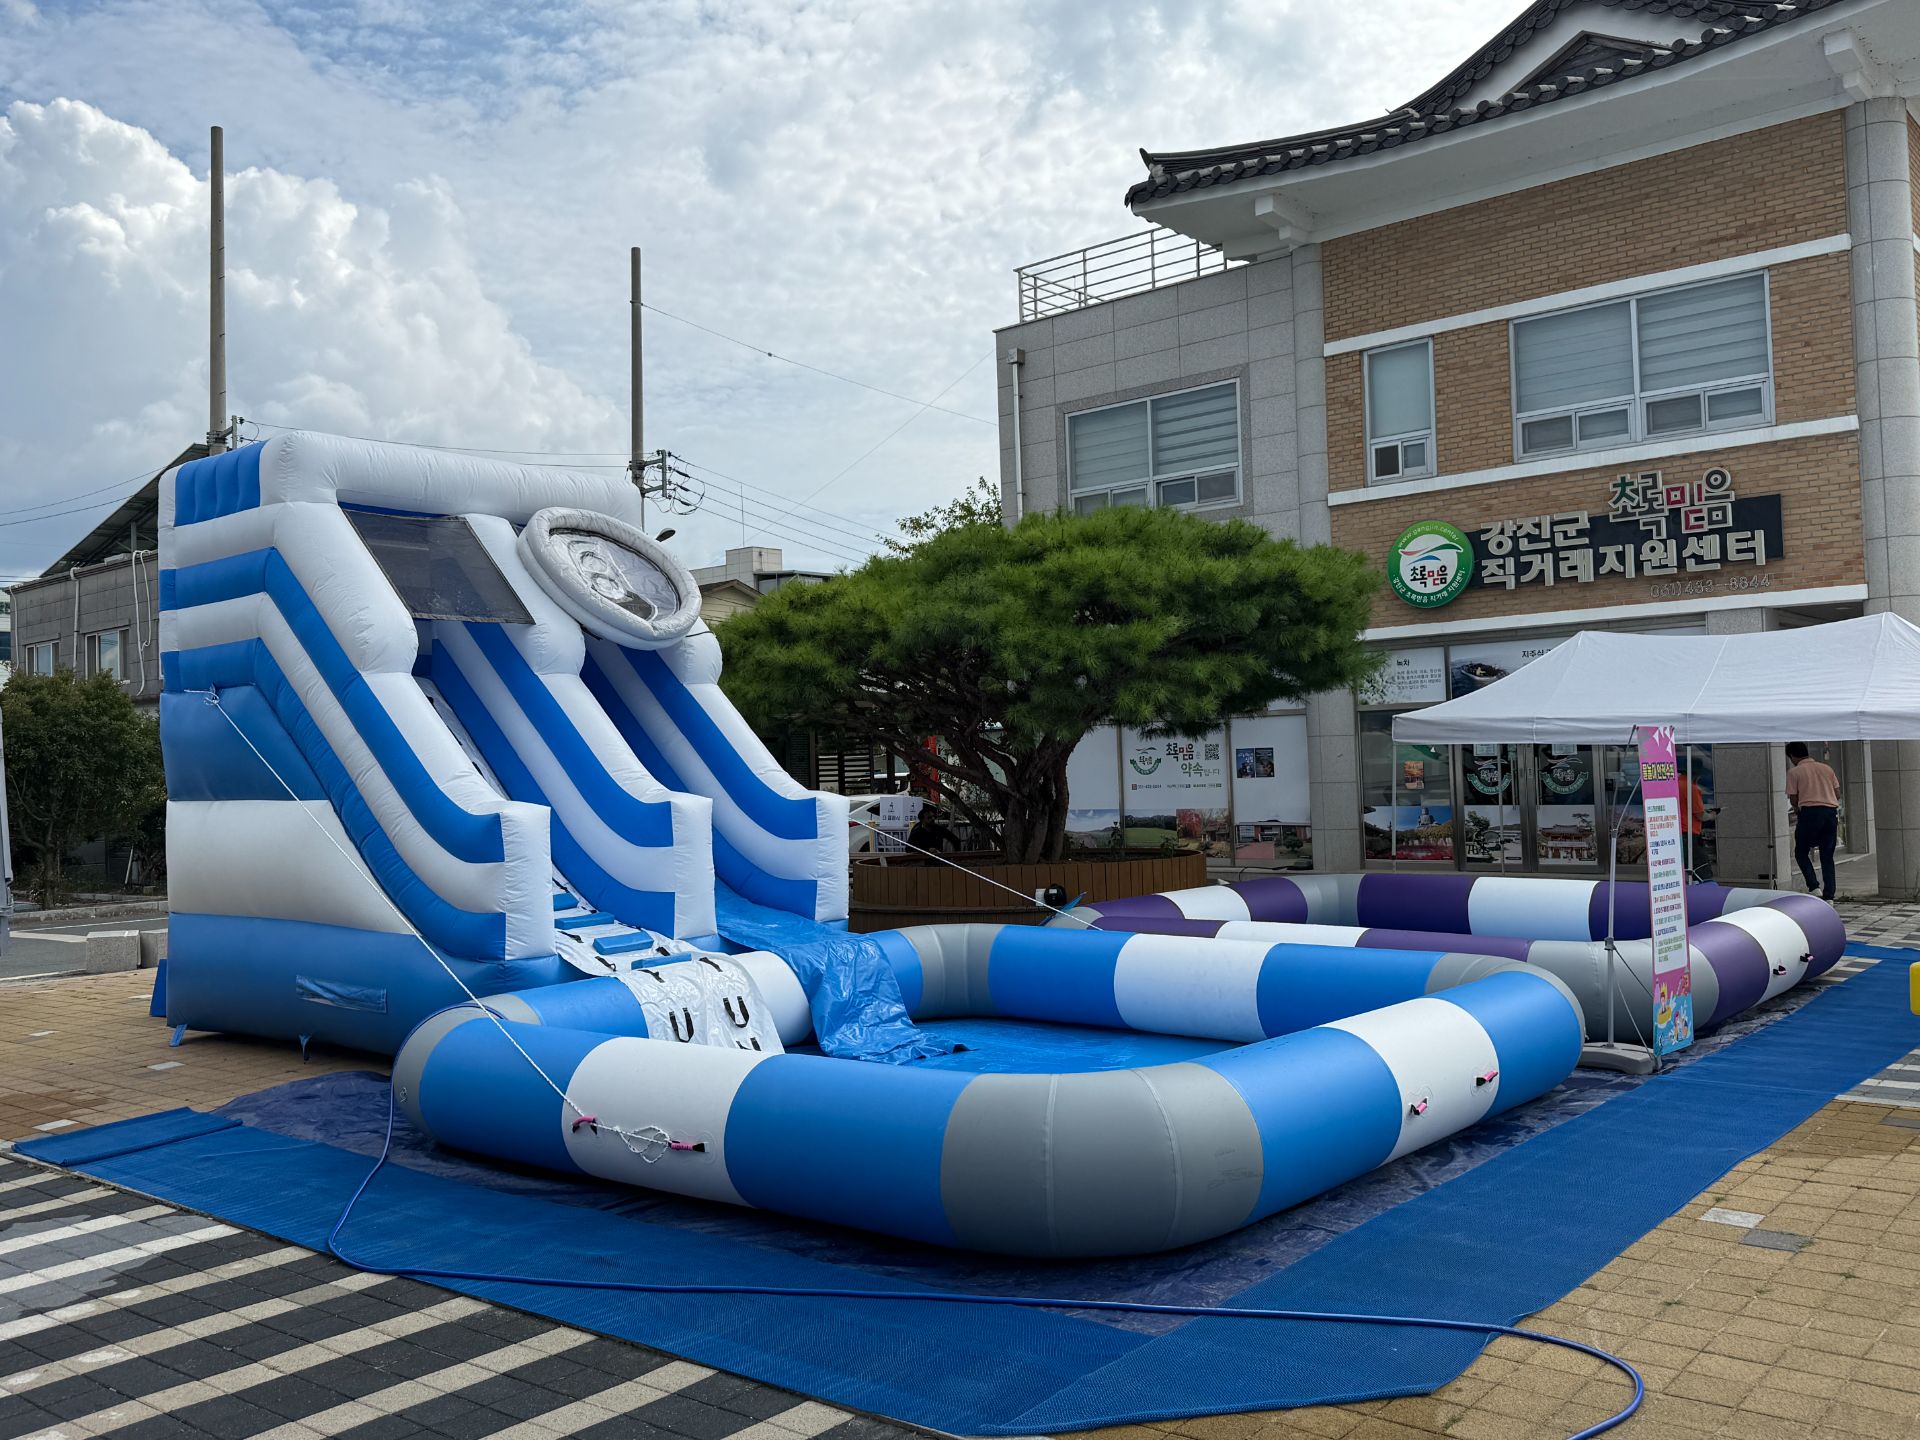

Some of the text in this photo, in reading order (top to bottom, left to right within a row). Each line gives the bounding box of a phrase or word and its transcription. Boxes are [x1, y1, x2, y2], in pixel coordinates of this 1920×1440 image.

[1609, 466, 1736, 540] 초록믿음
[1480, 510, 1591, 556] 강진군
[1410, 565, 1448, 588] 초록믿음
[1166, 743, 1194, 762] 초록믿음
